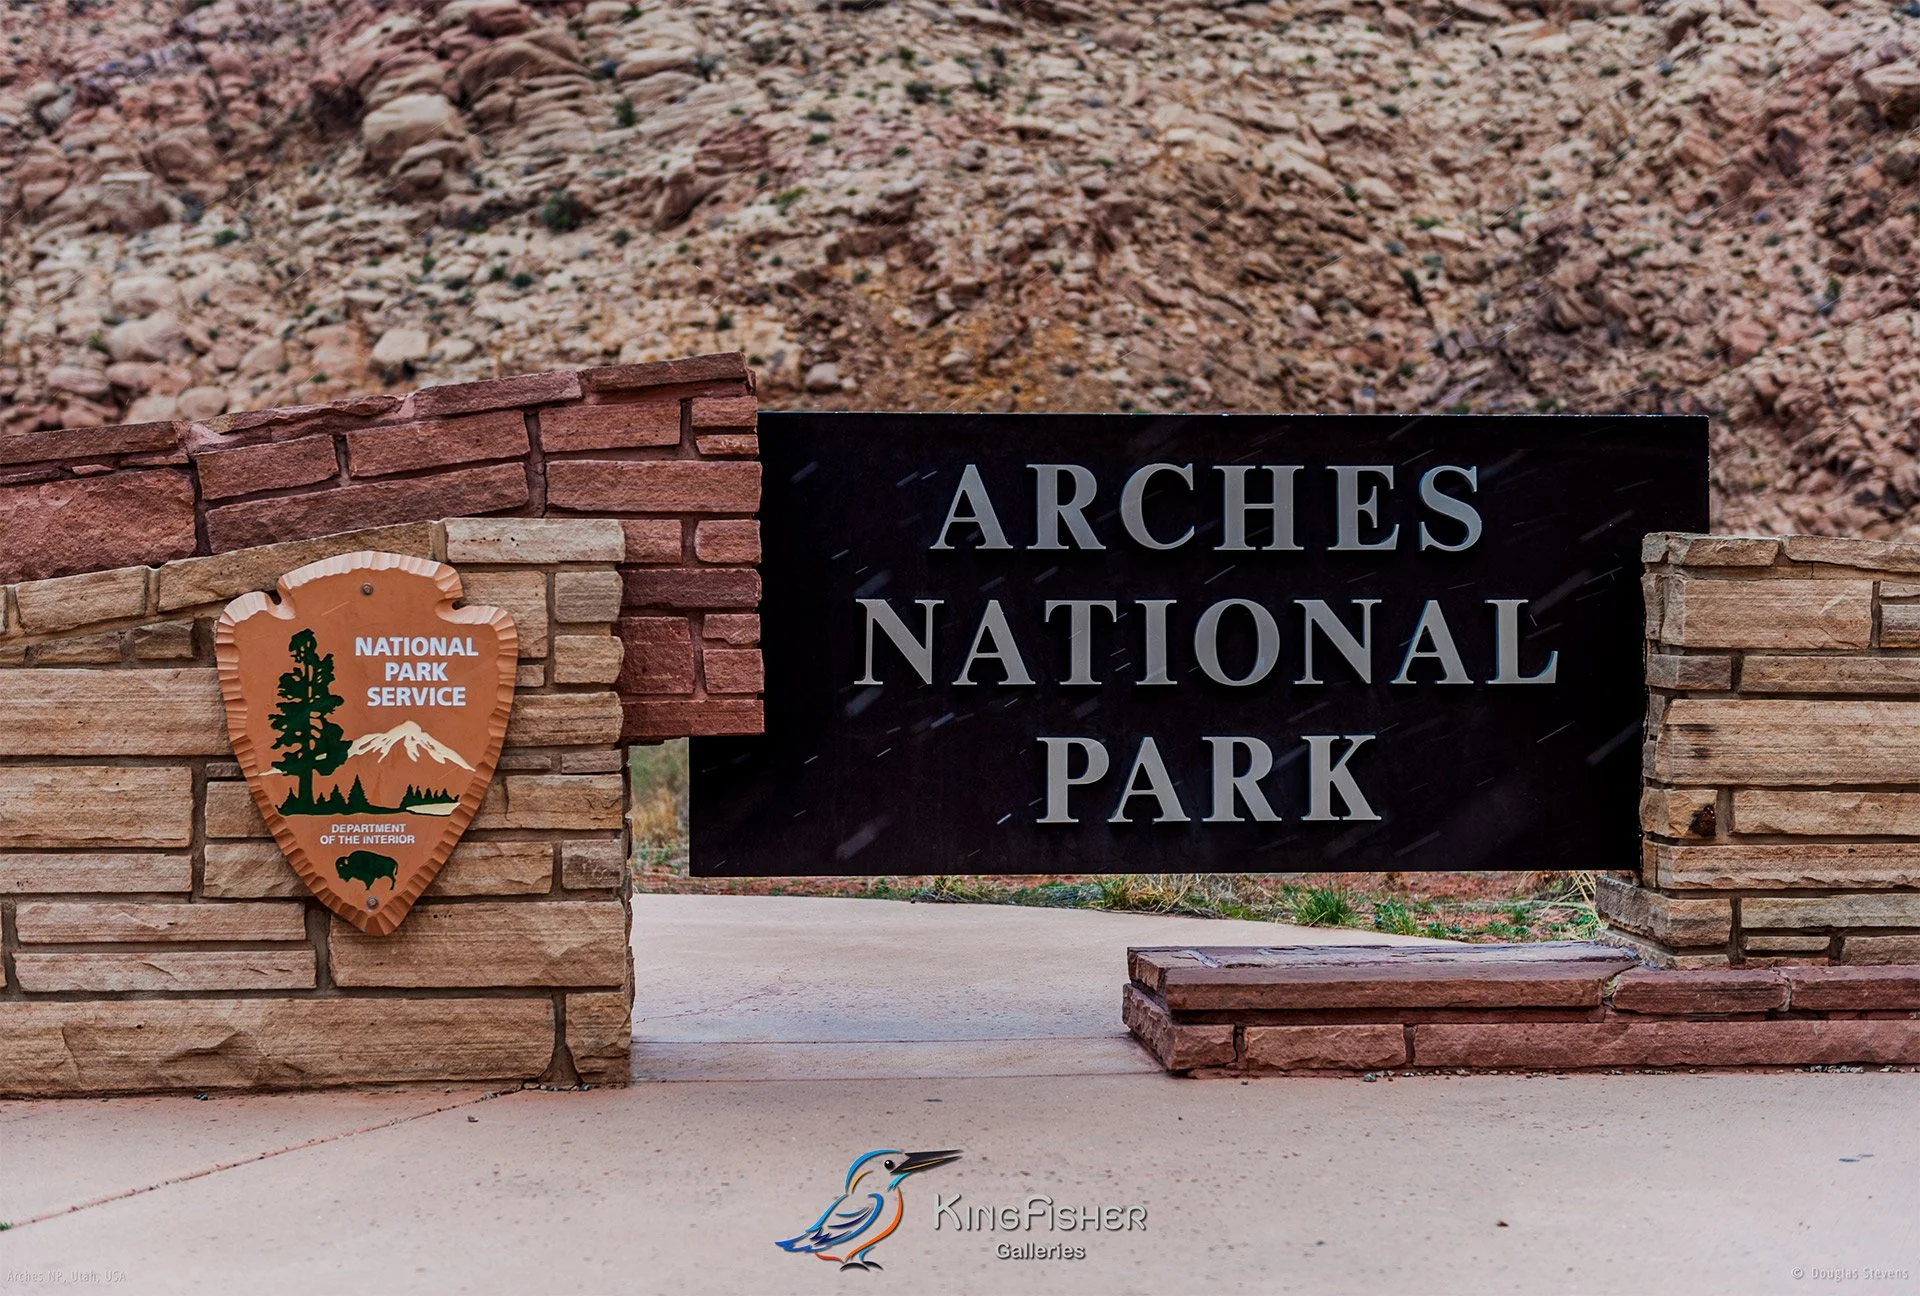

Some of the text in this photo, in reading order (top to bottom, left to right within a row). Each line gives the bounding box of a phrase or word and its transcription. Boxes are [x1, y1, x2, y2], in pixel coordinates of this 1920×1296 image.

[929, 463, 1483, 552] ARCHES
[355, 636, 479, 656] NATIONAL
[853, 598, 1559, 687] NATIONAL
[384, 662, 448, 682] PARK
[366, 686, 466, 707] SERVICE
[1034, 734, 1383, 824] PARK
[331, 823, 406, 834] DEPARTMENT
[319, 834, 416, 845] OF THE INTERIOR
